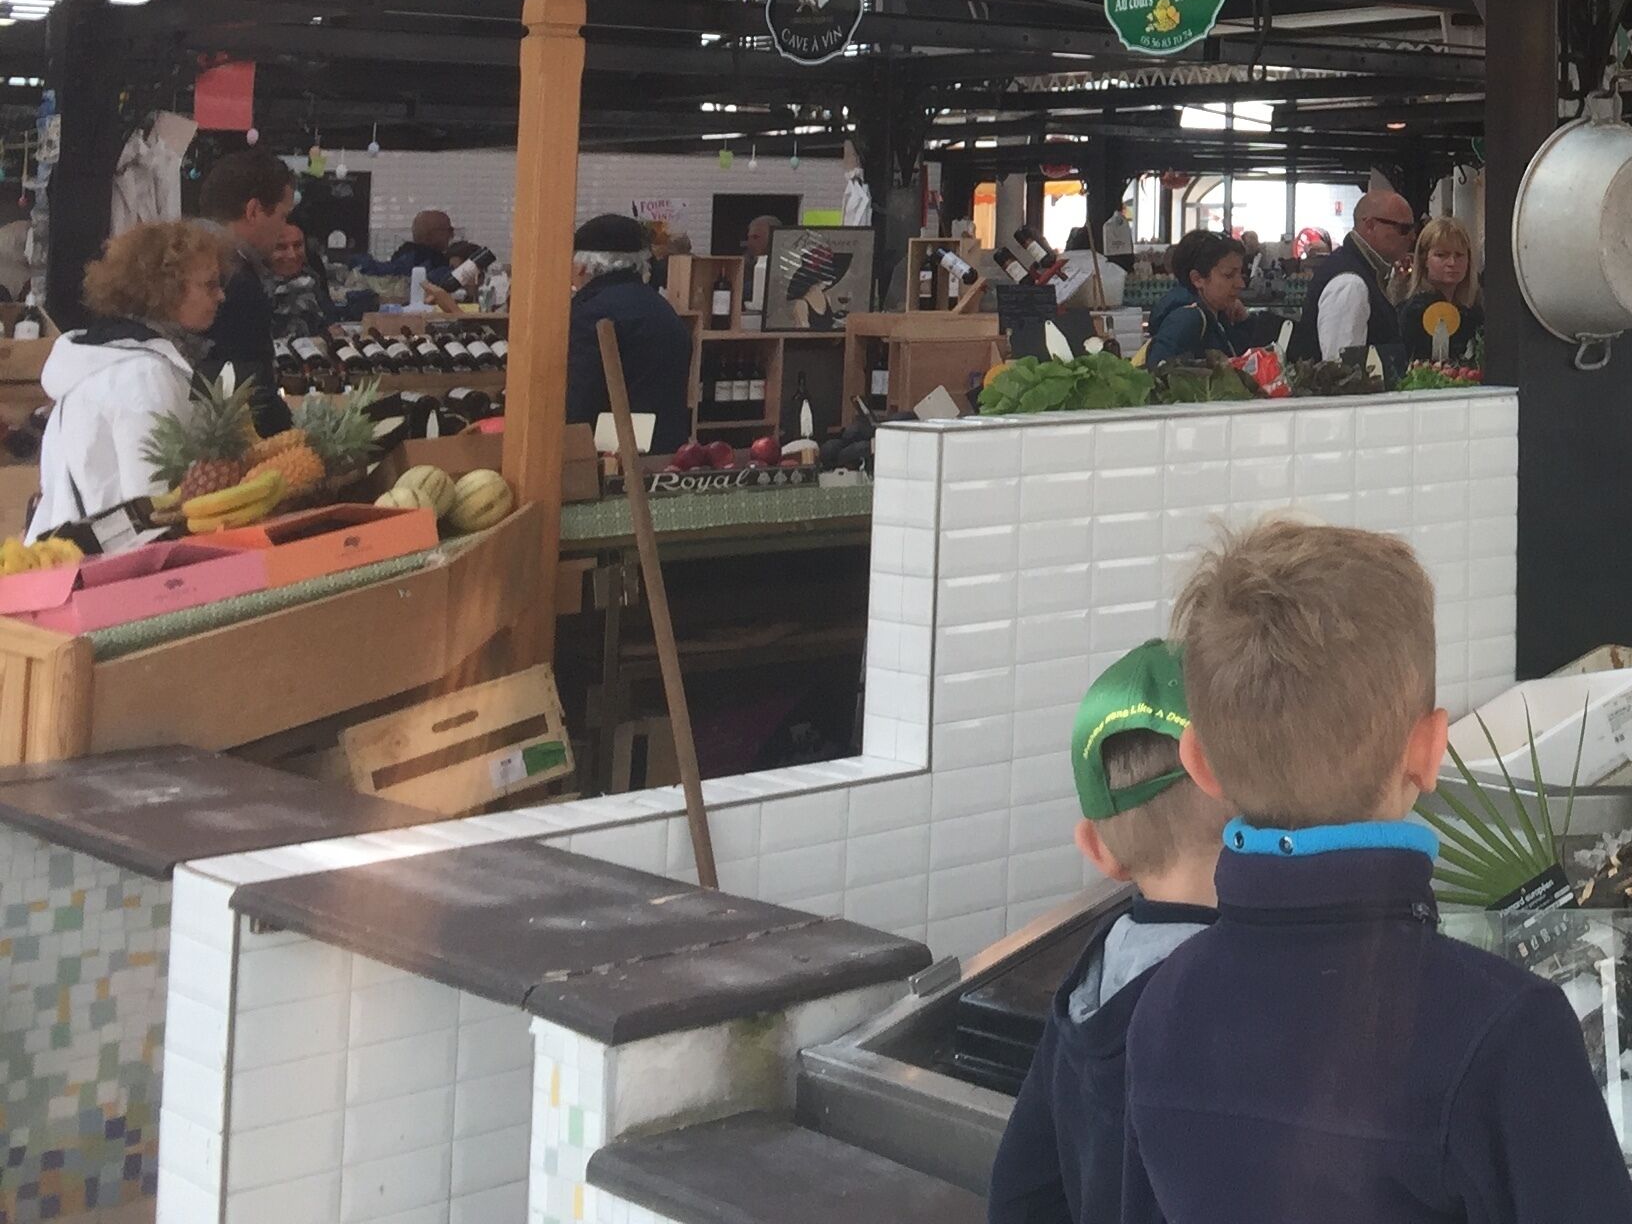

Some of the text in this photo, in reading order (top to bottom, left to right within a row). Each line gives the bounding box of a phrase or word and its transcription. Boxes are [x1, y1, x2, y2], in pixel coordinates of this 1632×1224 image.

[782, 28, 809, 51] CAVE
[822, 26, 843, 49] VIN
[649, 468, 750, 493] Royal
[1131, 703, 1153, 715] Like
[1155, 709, 1164, 718] A
